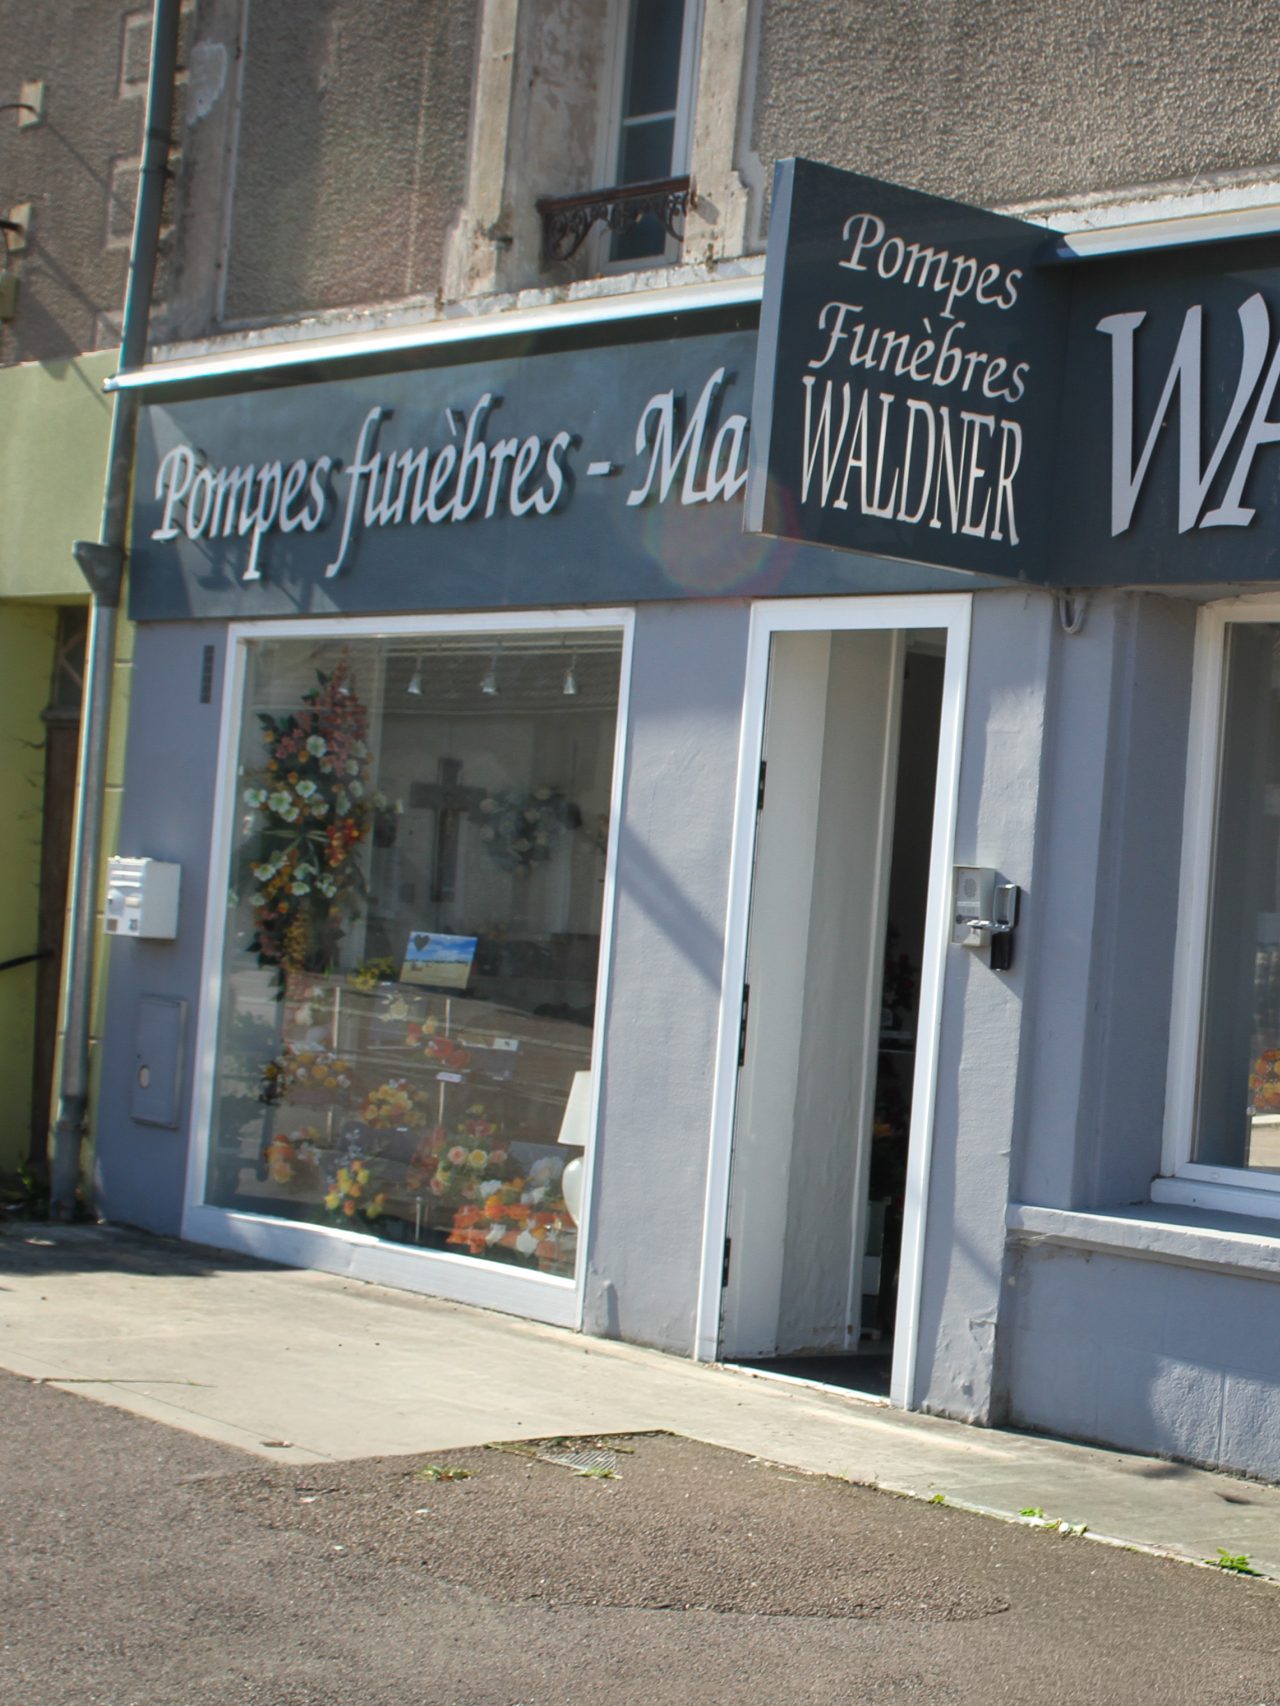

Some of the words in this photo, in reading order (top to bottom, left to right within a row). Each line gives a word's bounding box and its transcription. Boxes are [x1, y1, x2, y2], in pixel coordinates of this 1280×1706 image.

[838, 212, 1024, 319] Pompes
[807, 301, 1031, 403] Funèbres
[151, 443, 332, 581] Pompes
[324, 392, 572, 579] funèbres
[801, 375, 1023, 546] WALDNER
